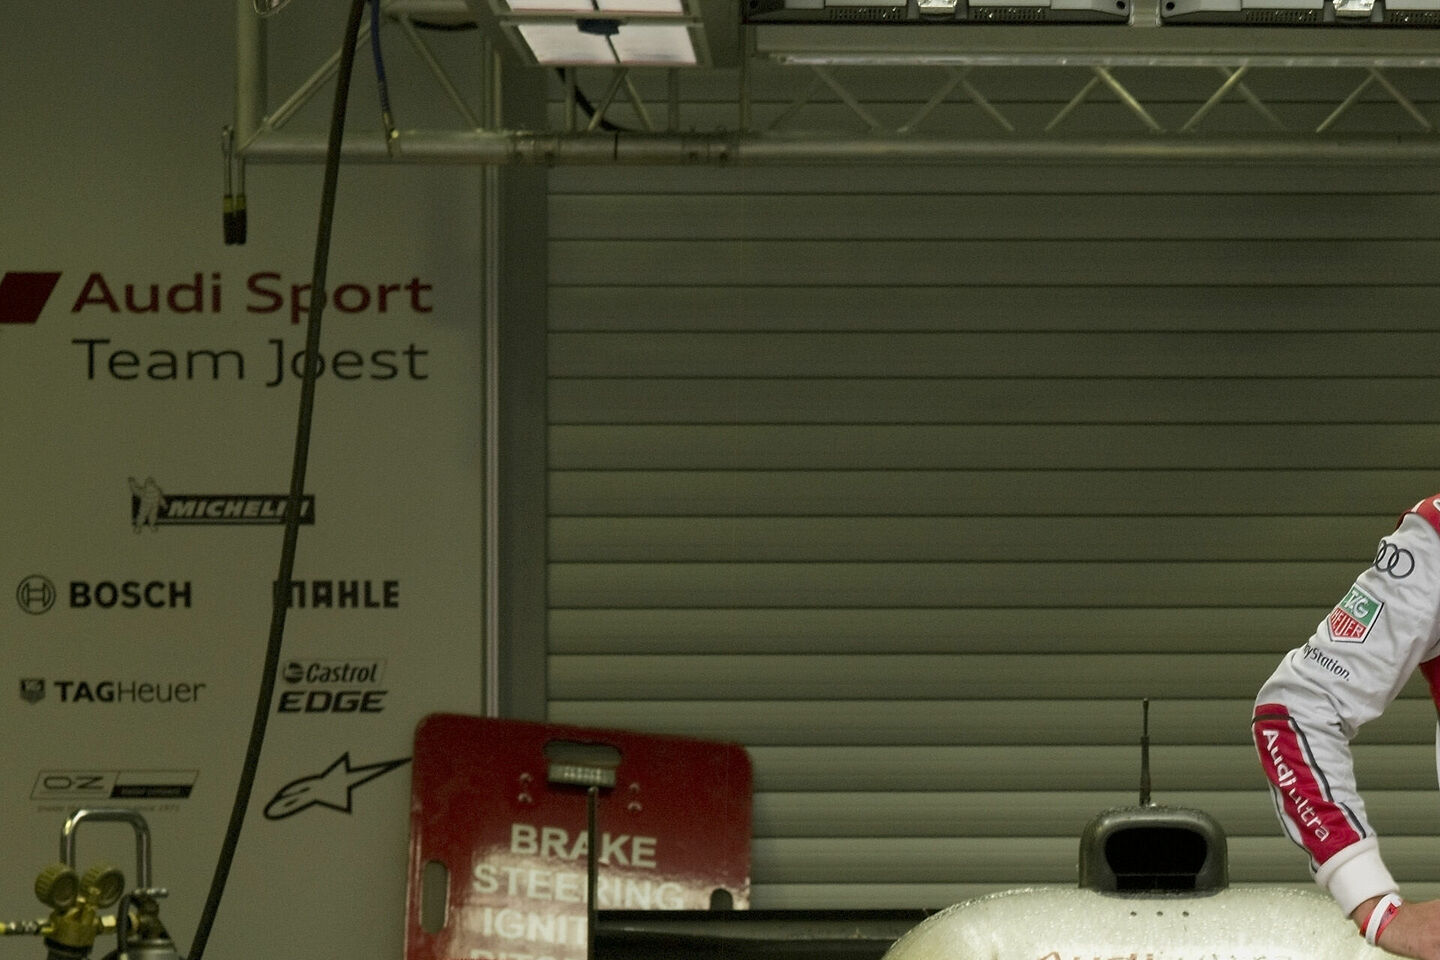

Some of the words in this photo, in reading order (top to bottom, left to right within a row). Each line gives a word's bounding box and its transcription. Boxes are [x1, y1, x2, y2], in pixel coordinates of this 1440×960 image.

[70, 271, 222, 314] Audi
[246, 272, 434, 325] Sport
[72, 338, 245, 380] Team
[266, 339, 429, 388] Joest
[69, 581, 192, 608] BOSCH
[305, 663, 379, 684] Castrol
[278, 690, 389, 713] EDGE
[510, 823, 657, 868] BRAKE
[473, 863, 684, 910] STEERING
